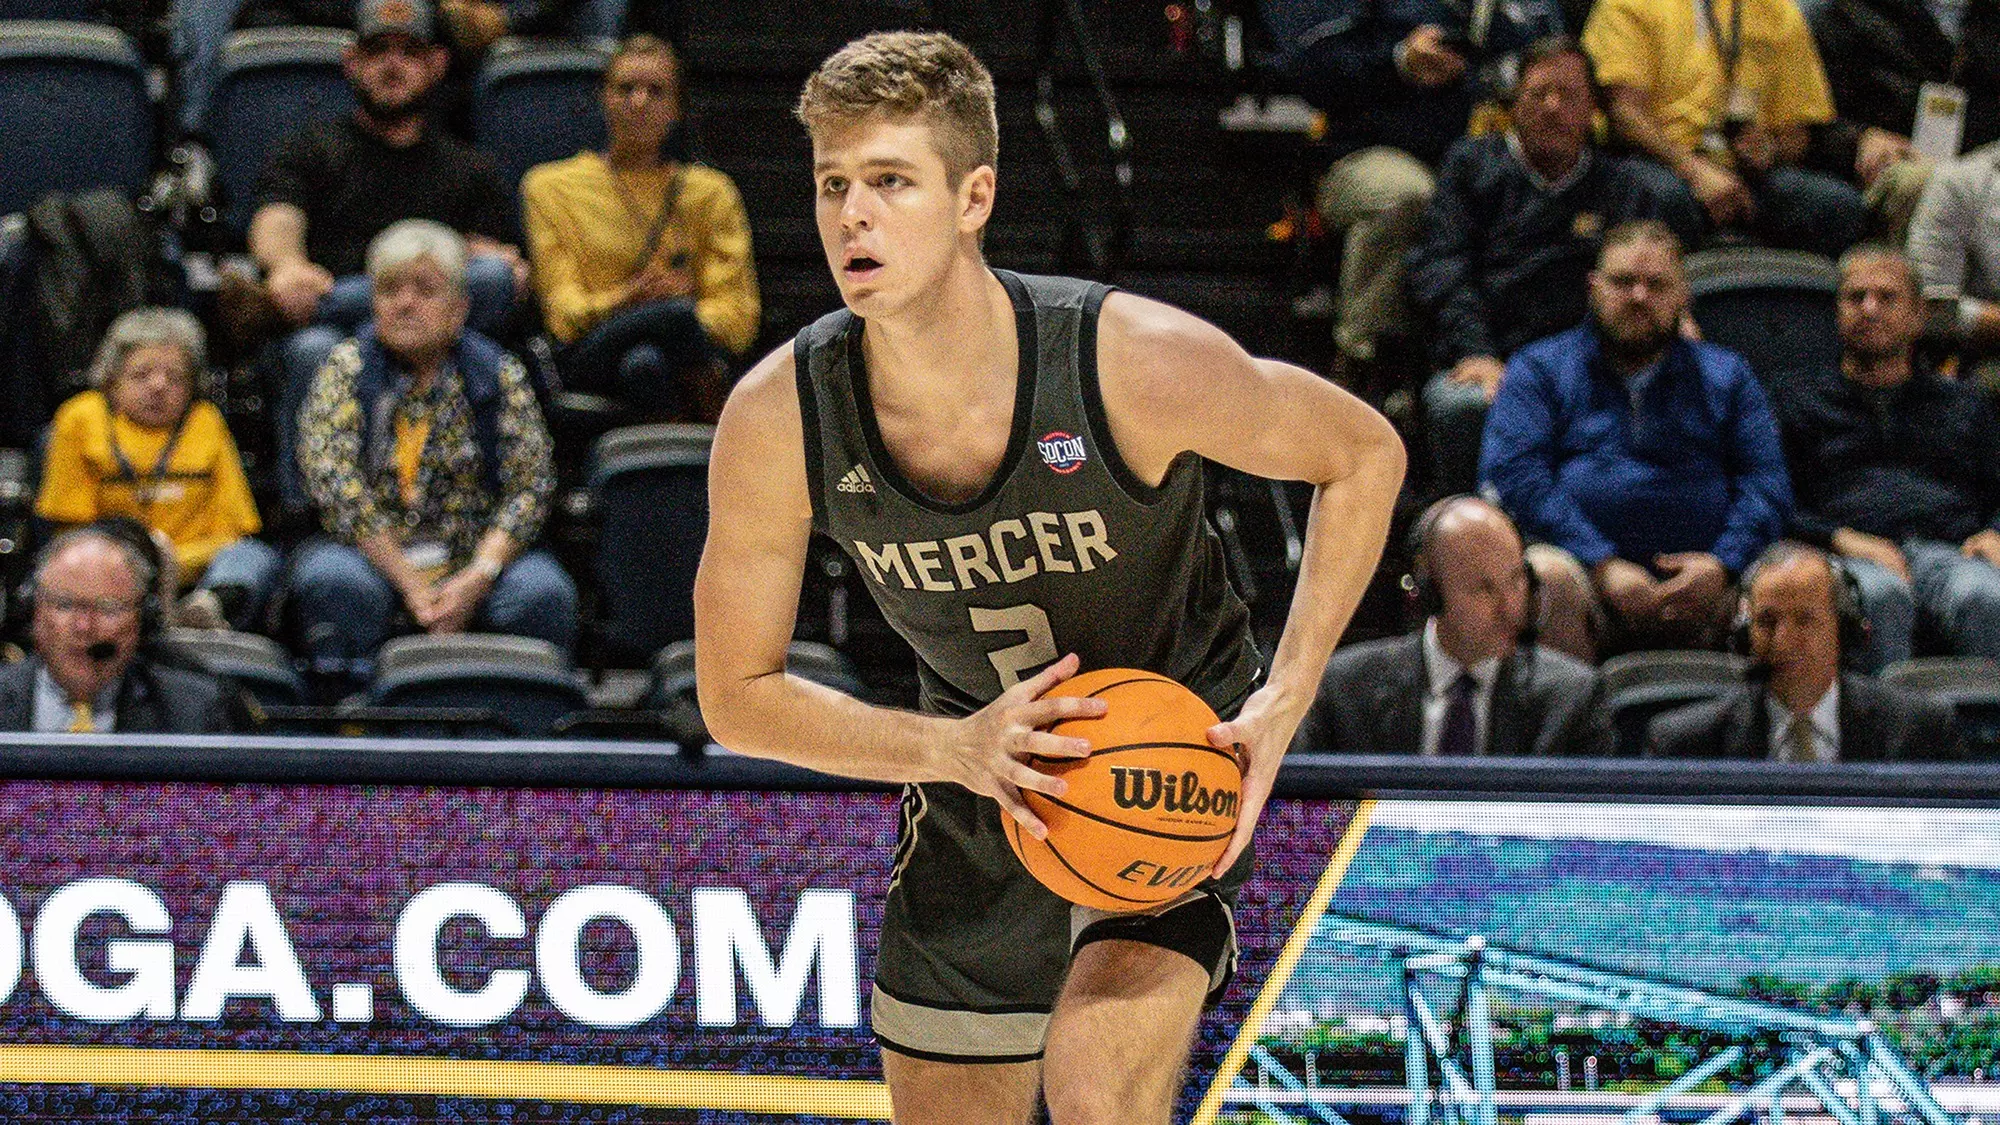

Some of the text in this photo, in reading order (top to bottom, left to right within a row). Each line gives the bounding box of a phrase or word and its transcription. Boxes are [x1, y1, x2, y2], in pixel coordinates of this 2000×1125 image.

[1037, 436, 1086, 464] SOCON
[837, 482, 876, 493] adida
[853, 509, 1118, 591] MERCER
[968, 603, 1059, 692] 2
[1110, 766, 1239, 819] Wilson
[0, 878, 863, 1029] GA.COM
